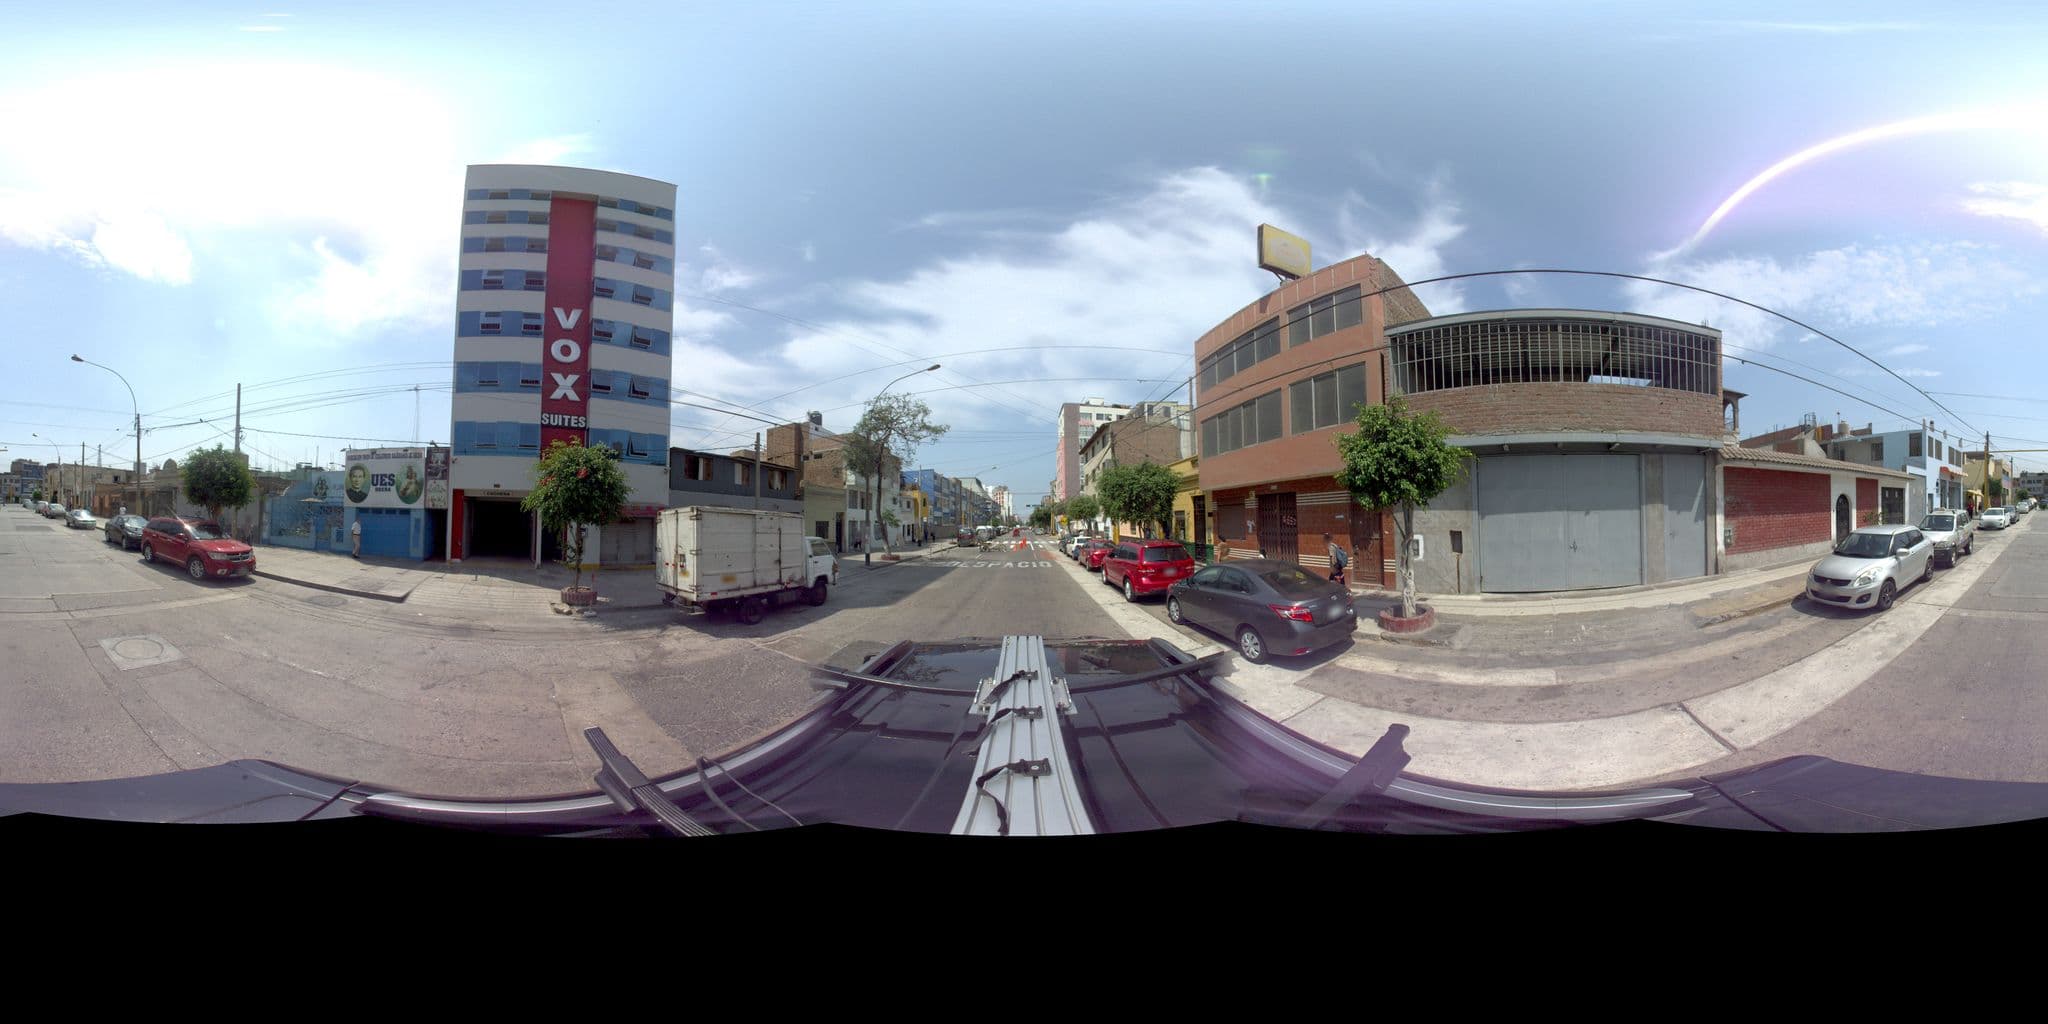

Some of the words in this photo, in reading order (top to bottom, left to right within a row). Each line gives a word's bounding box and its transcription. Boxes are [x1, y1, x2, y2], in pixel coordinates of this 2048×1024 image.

[550, 307, 583, 401] VOX
[542, 413, 586, 428] SUITES
[371, 473, 396, 486] UES
